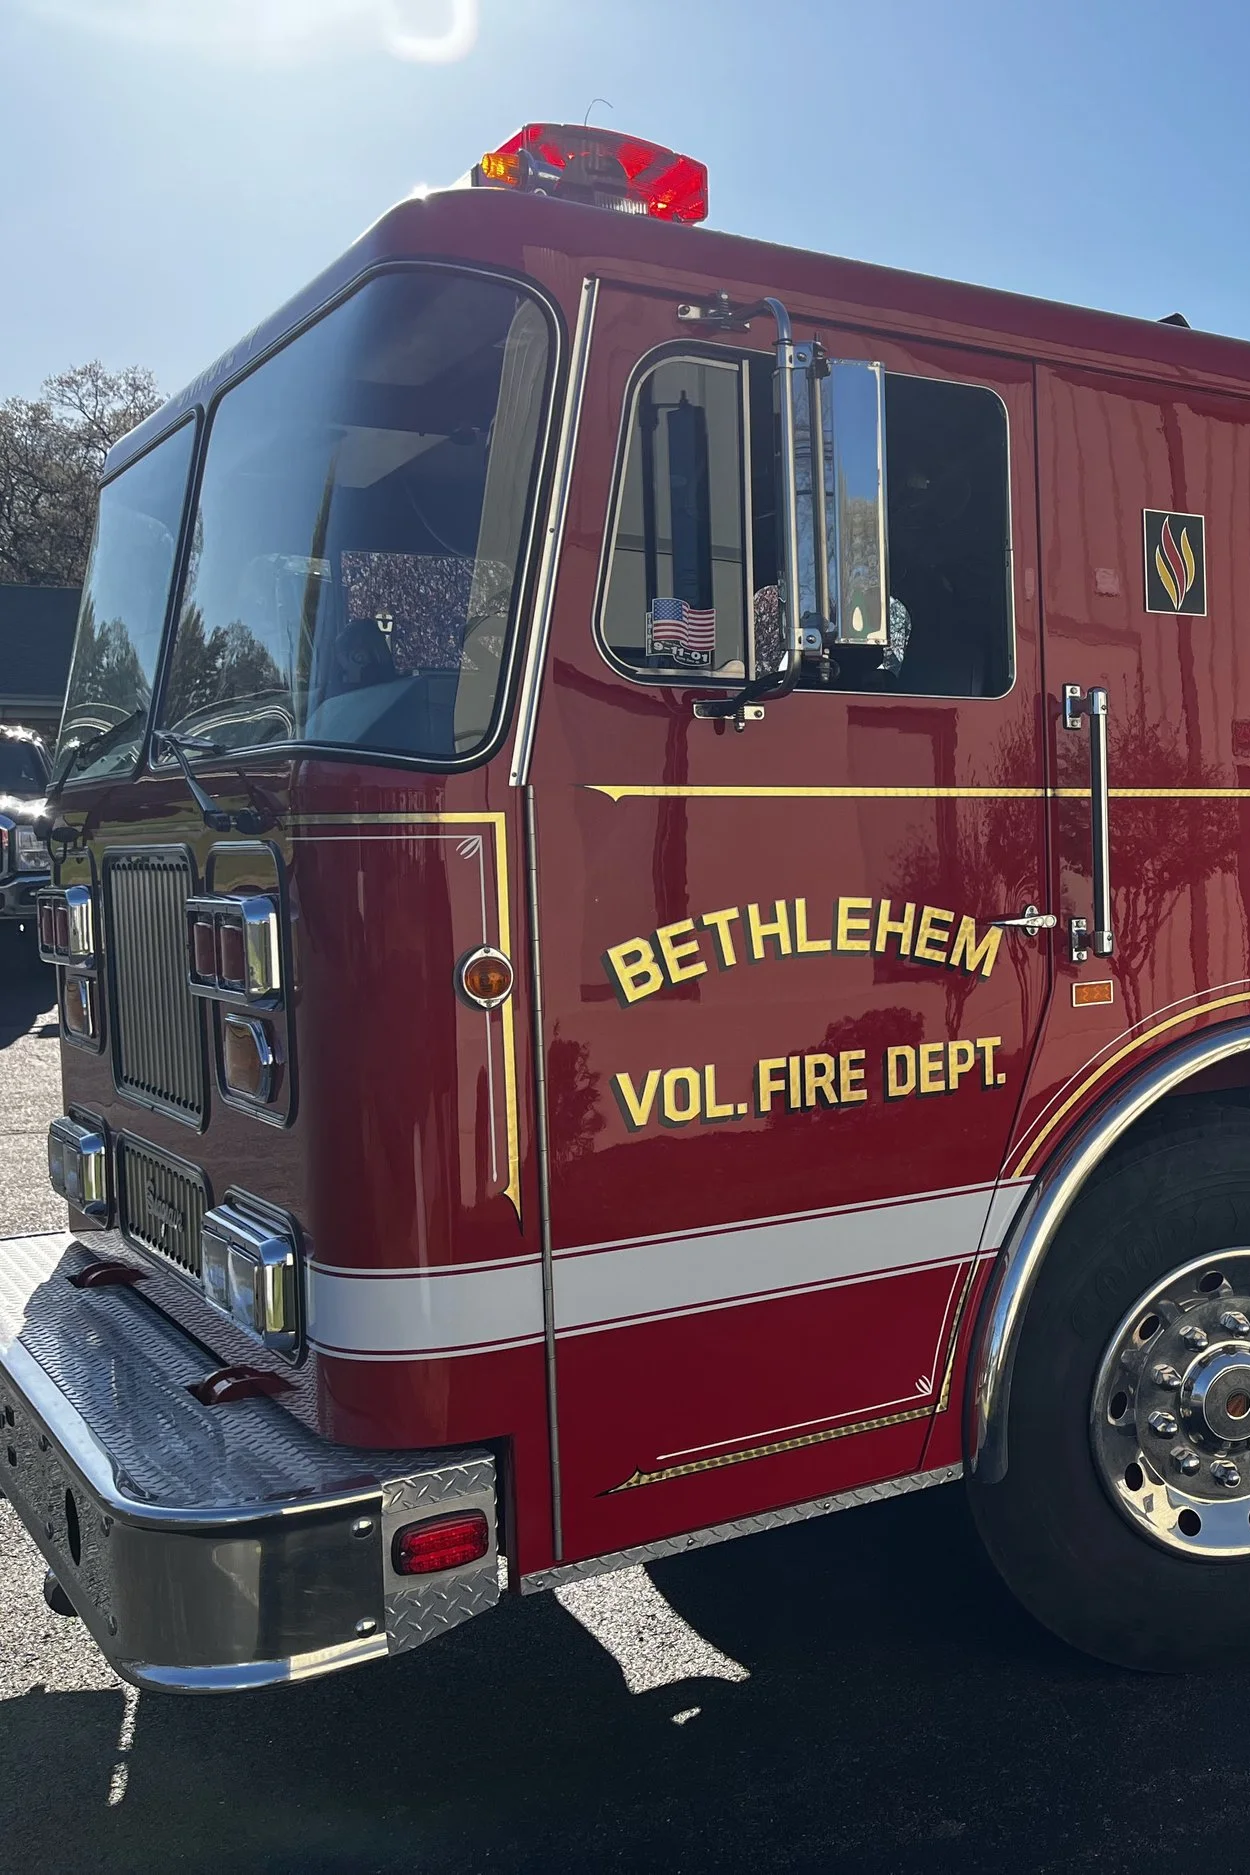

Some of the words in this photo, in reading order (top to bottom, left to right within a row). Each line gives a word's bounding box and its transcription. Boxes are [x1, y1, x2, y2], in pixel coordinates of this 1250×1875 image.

[653, 641, 708, 662] 9-11-01
[604, 896, 1004, 1005] BETHLEHEM
[612, 1063, 749, 1128] VOL.
[757, 1048, 868, 1113] FIRE
[886, 1035, 1007, 1097] DEPT.
